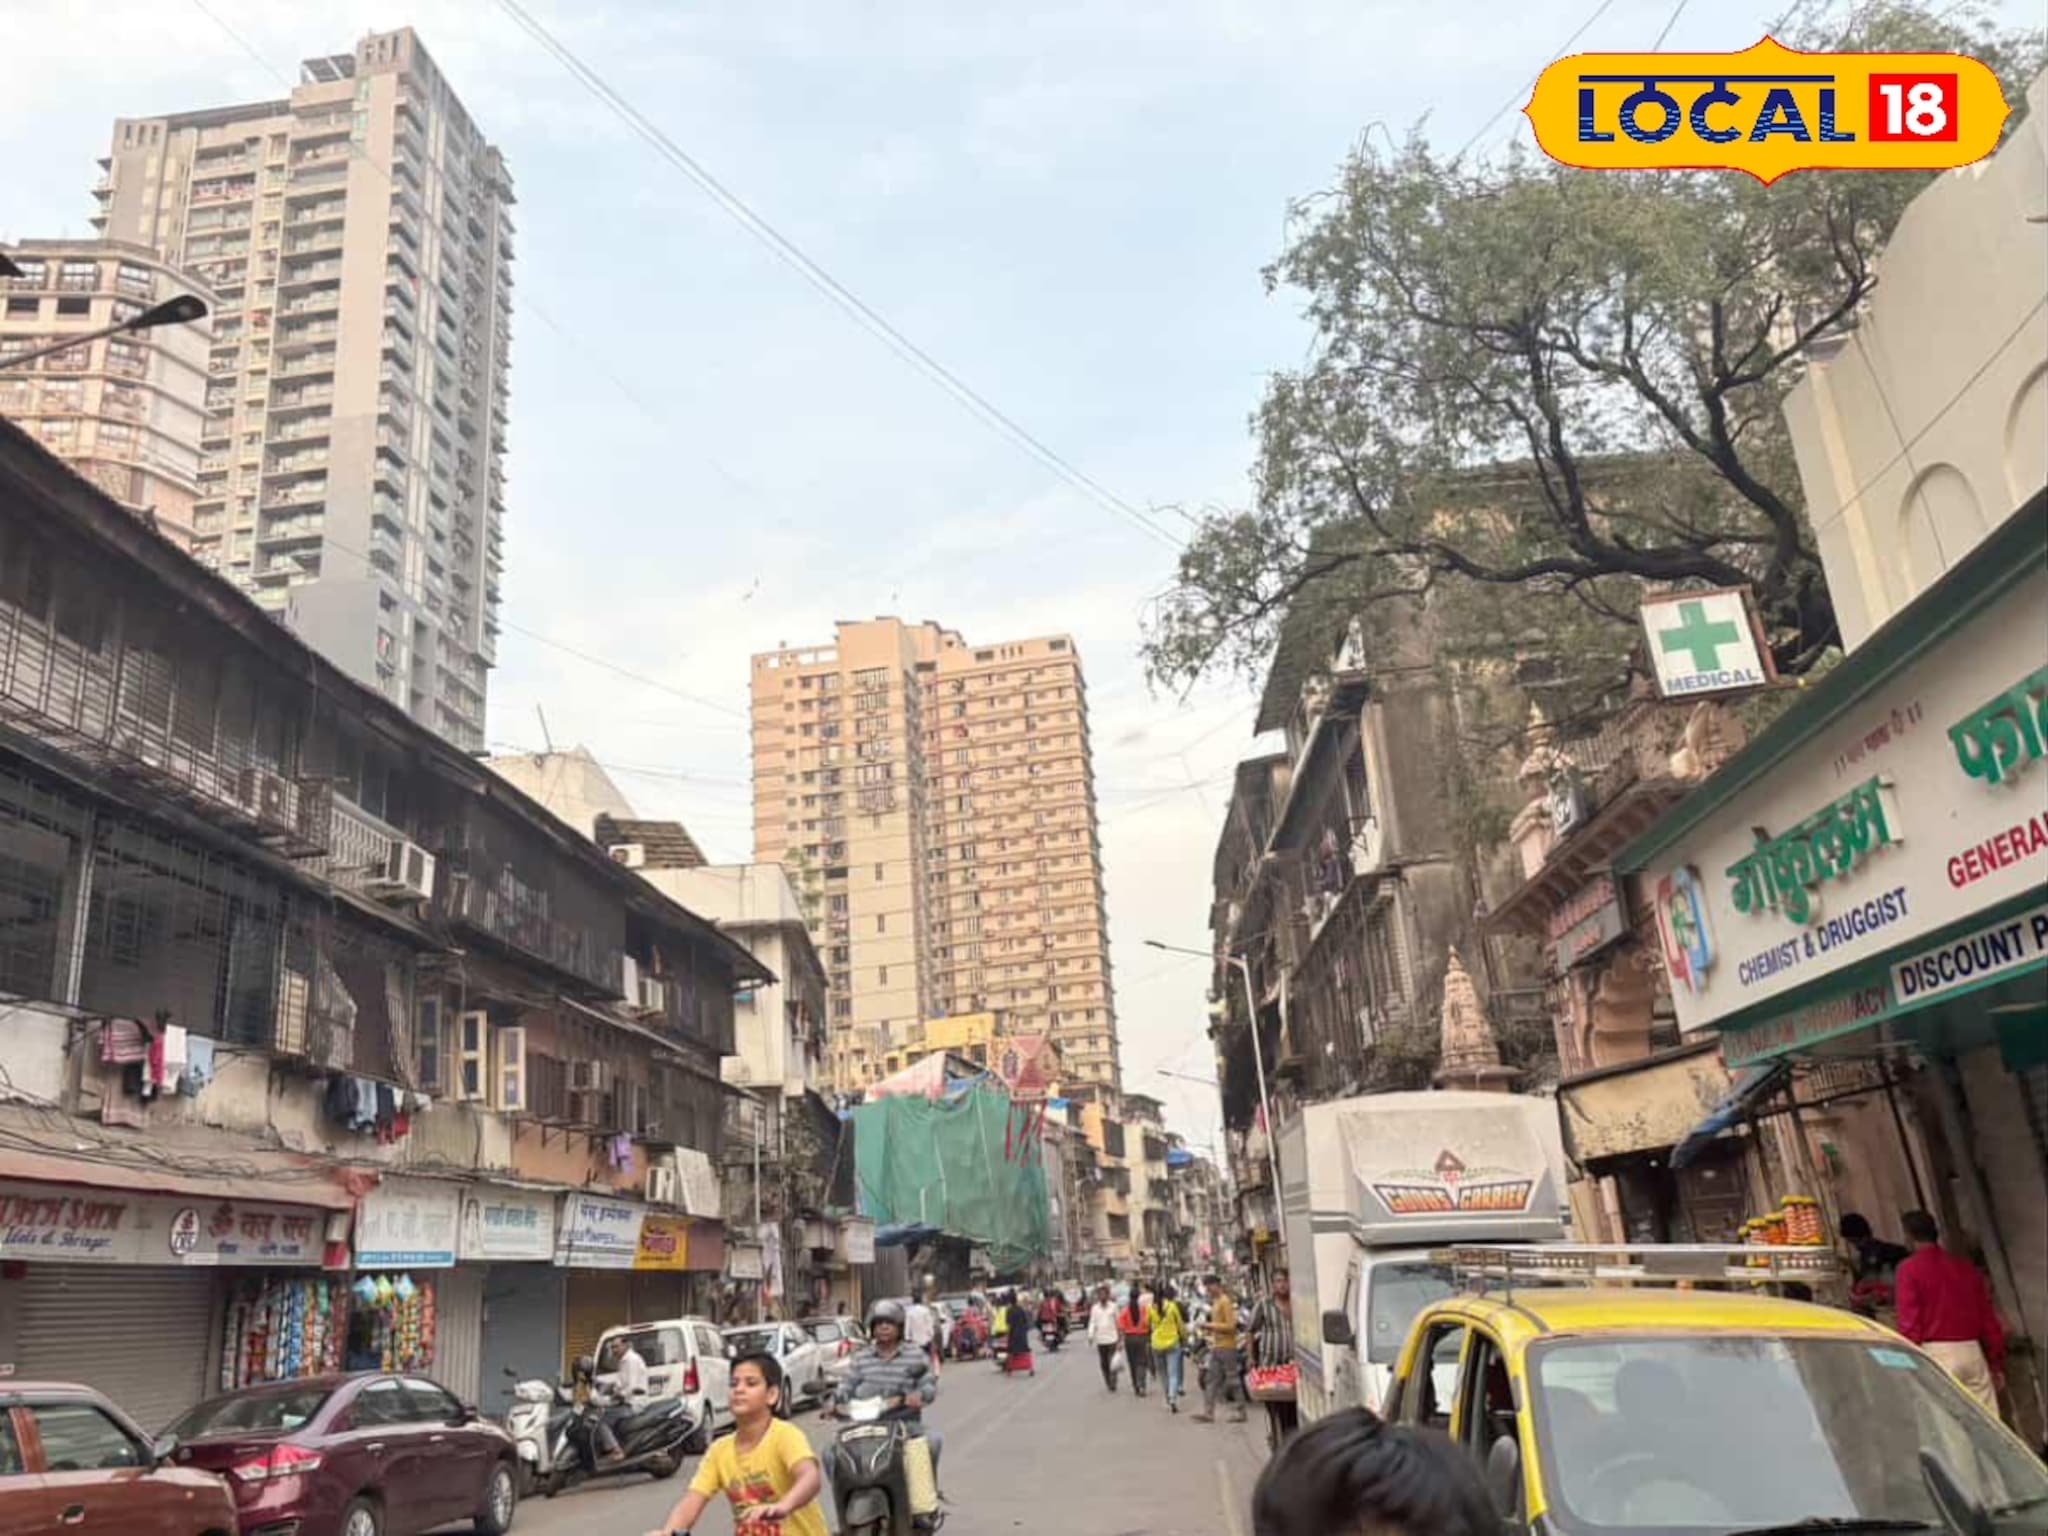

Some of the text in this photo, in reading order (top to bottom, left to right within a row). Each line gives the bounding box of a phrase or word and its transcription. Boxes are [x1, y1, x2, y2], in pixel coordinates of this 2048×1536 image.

[1665, 668, 1759, 692] MEDICAL
[1738, 811, 2048, 986] CHEMIST & DRUGGIST GENERA
[1899, 922, 2024, 996] DISCOUNT
